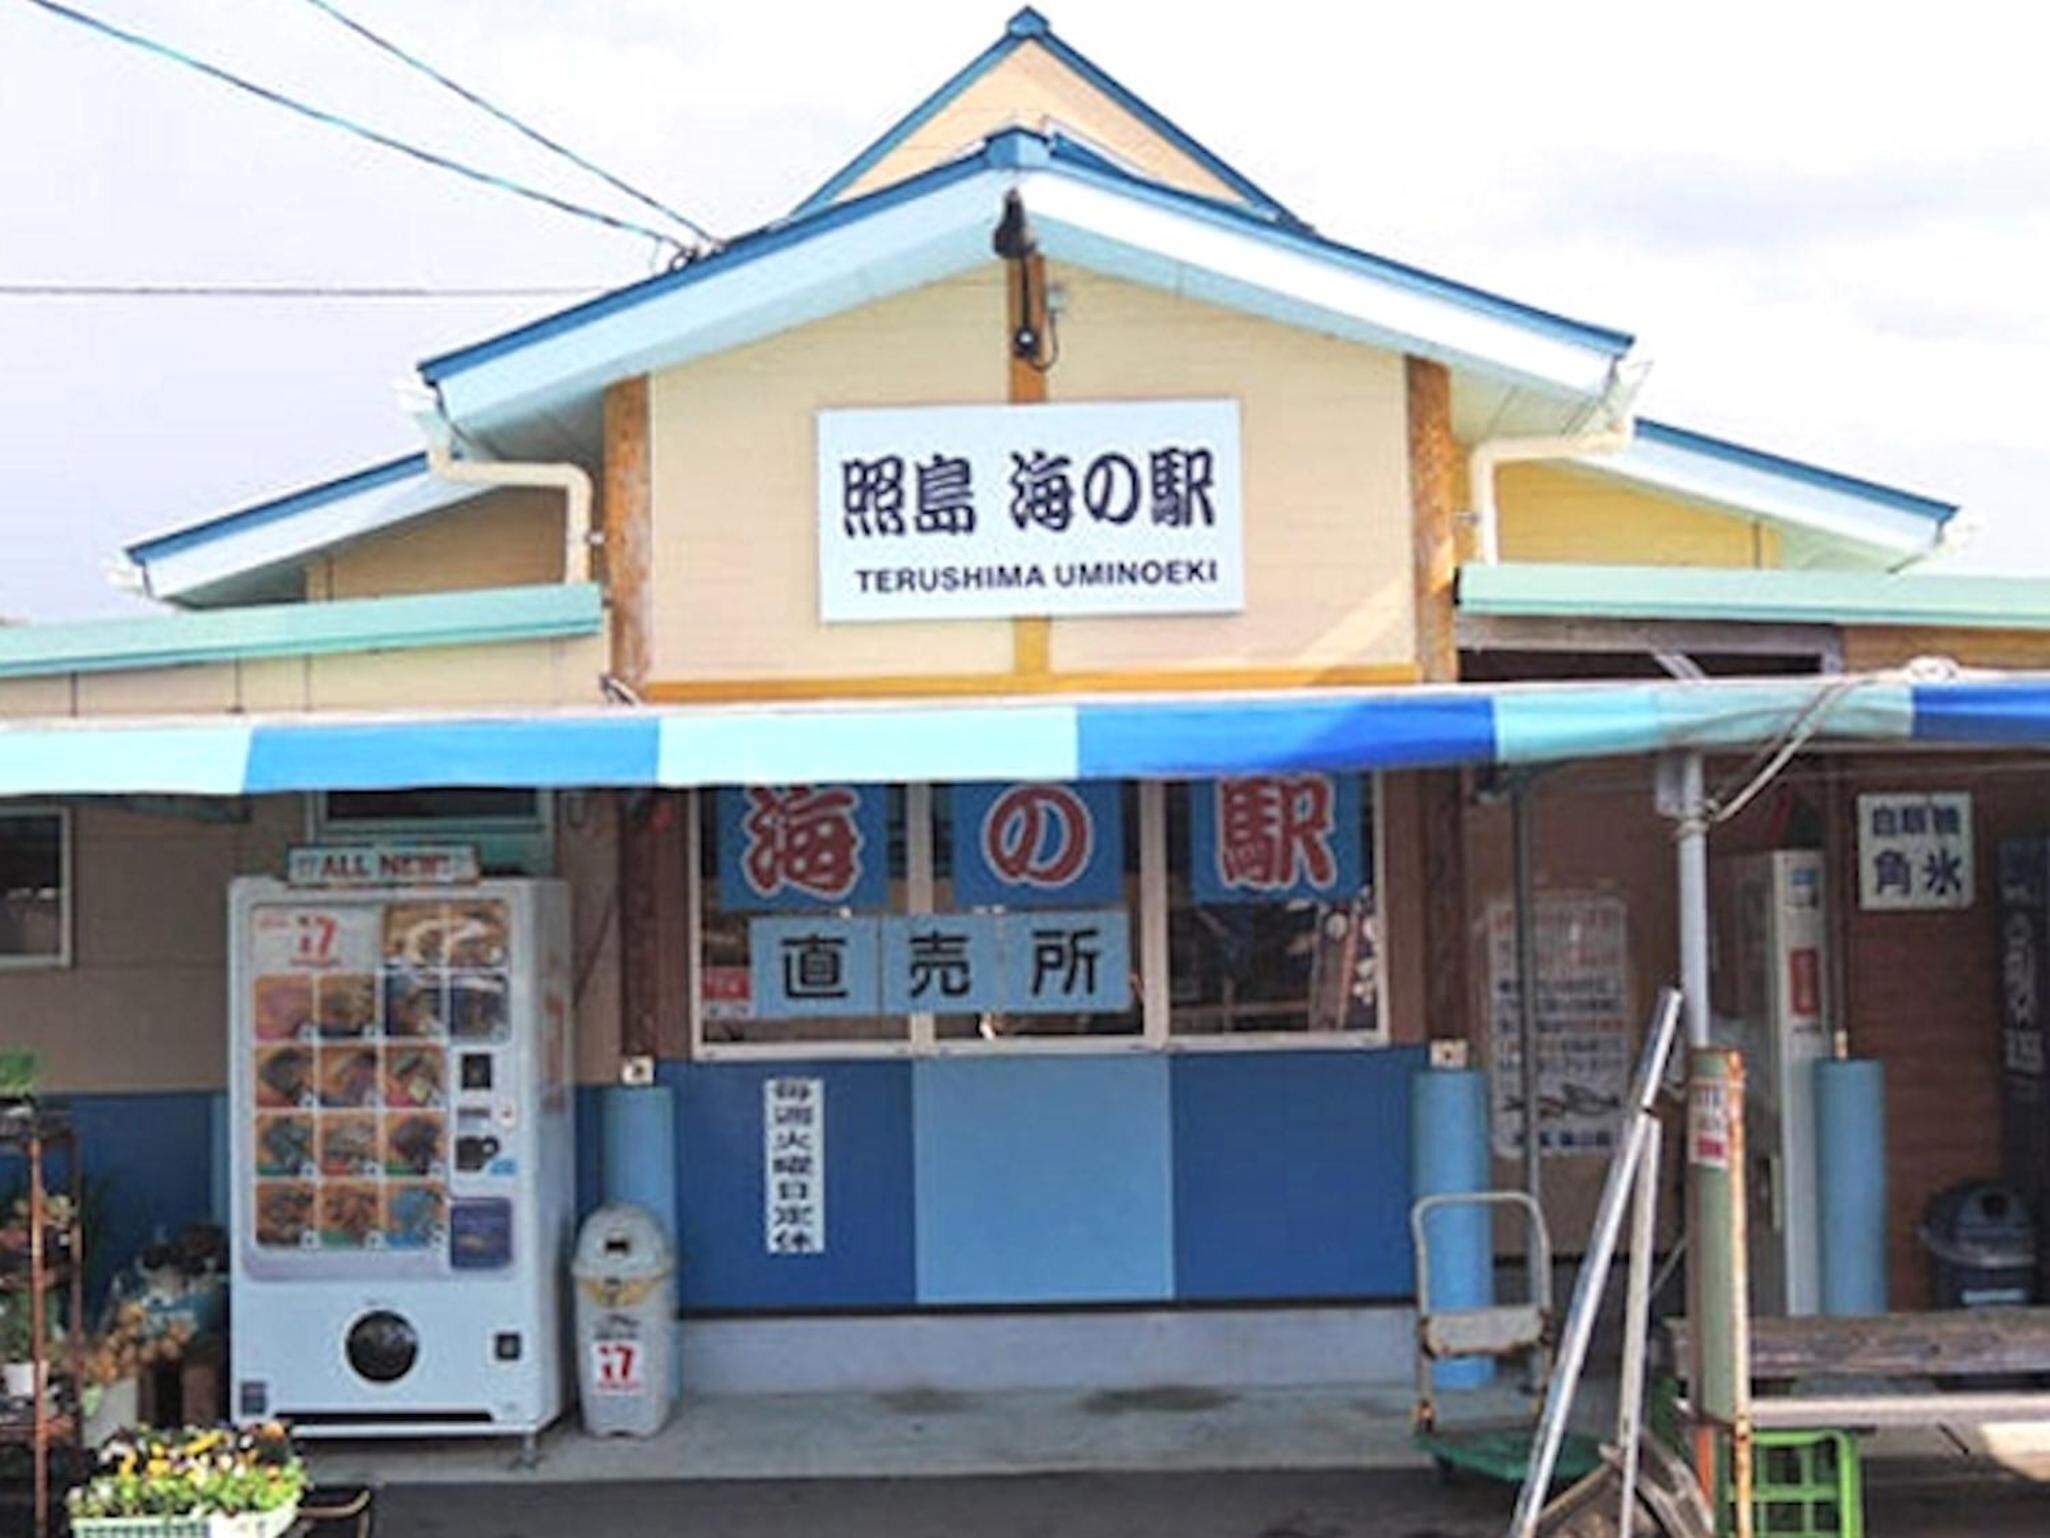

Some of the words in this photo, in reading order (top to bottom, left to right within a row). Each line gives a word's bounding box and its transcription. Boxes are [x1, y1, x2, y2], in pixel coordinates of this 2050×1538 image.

[841, 454, 976, 538] 照島
[1010, 447, 1216, 532] 海の駅
[856, 563, 1046, 593] TERUSHIMA
[1054, 558, 1218, 588] UMINOEKI
[778, 928, 1106, 999] 直売所
